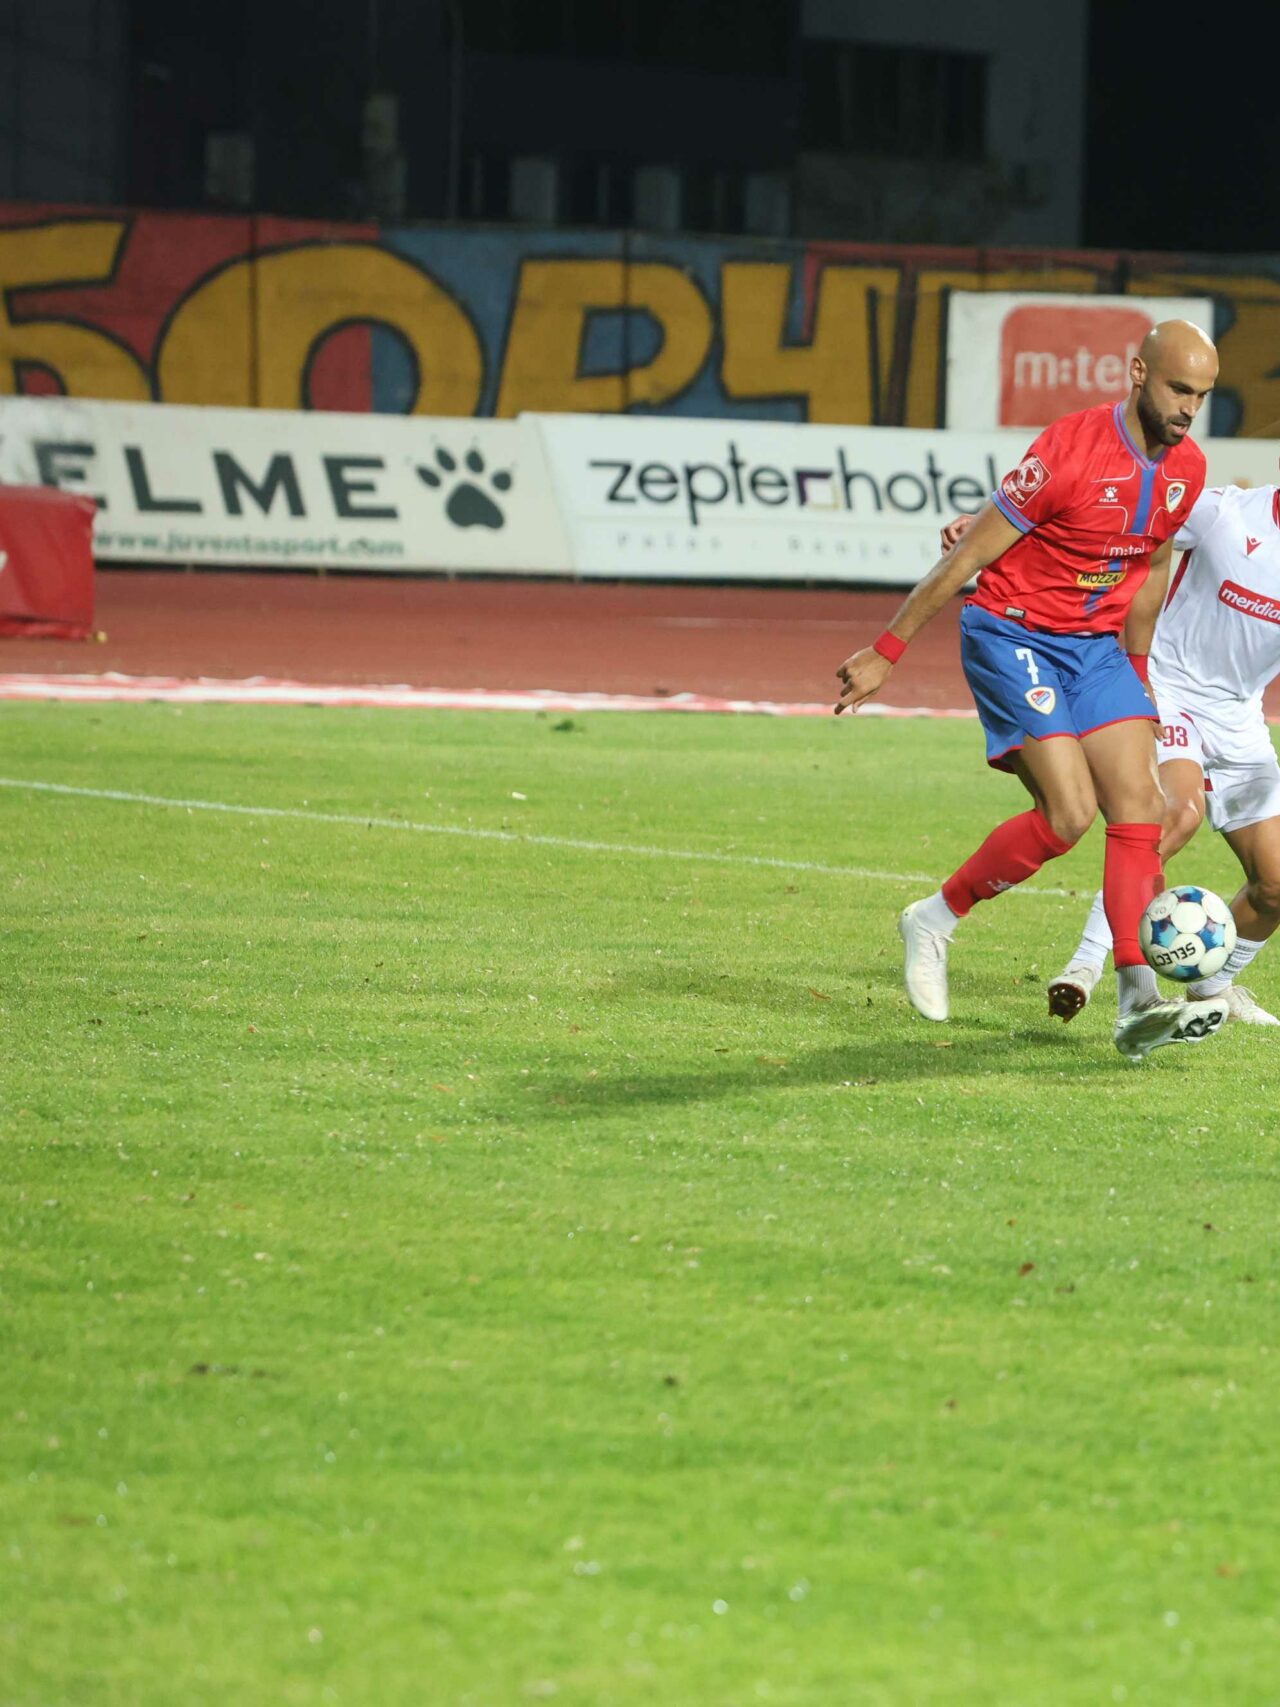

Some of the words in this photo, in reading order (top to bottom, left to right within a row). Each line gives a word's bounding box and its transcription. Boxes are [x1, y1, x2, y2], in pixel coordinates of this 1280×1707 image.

[0, 437, 399, 519] ELME
[1110, 541, 1145, 556] m:tel
[1079, 573, 1120, 584] MOZZA
[1015, 648, 1039, 685] 7
[1162, 725, 1189, 747] 93
